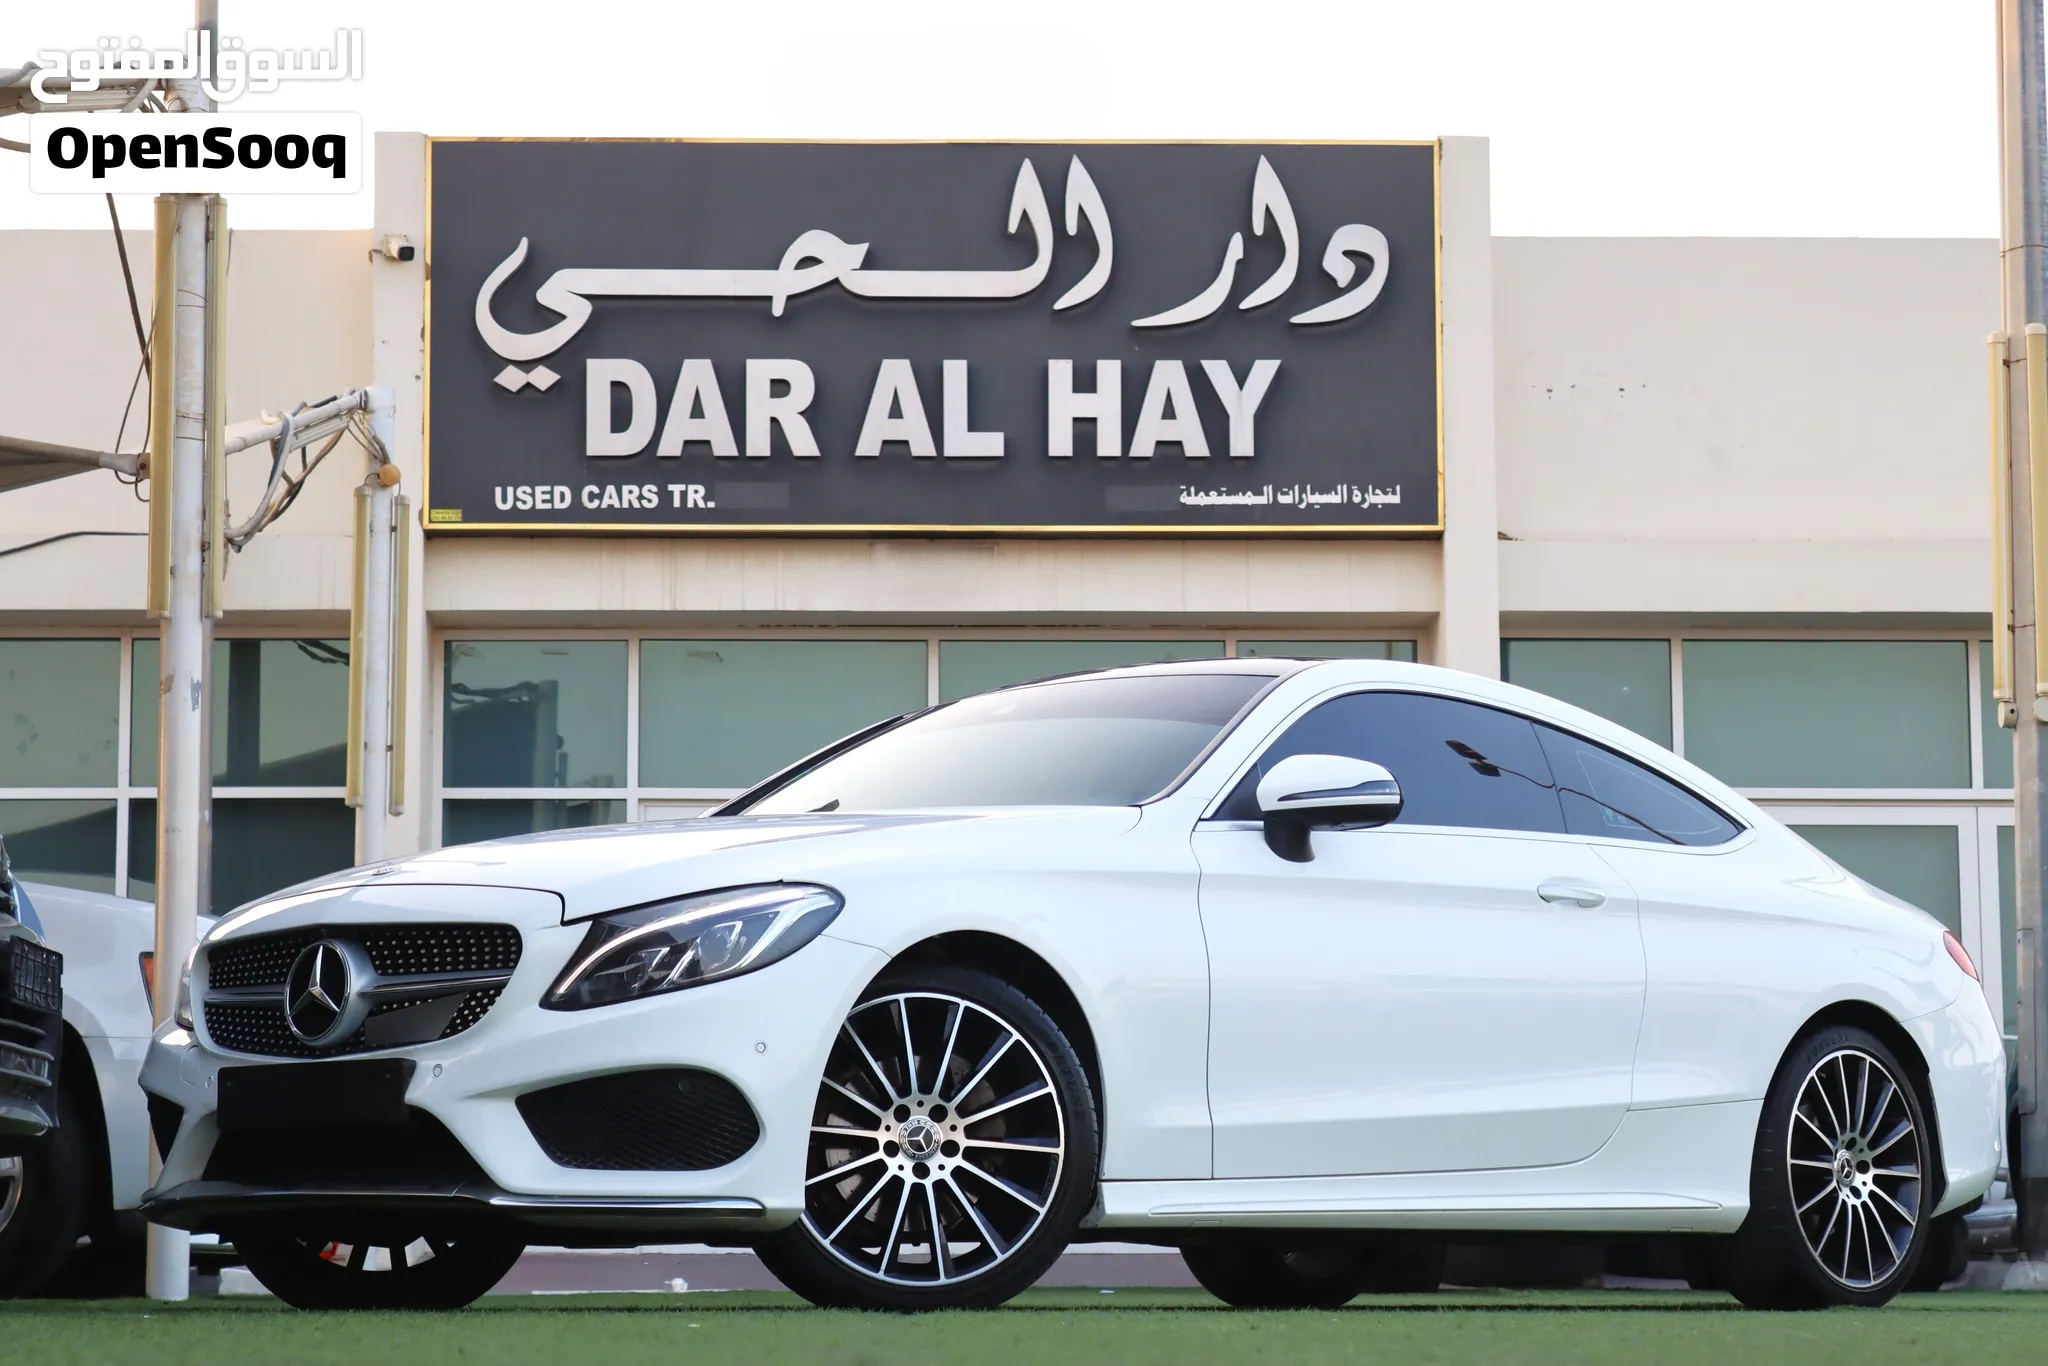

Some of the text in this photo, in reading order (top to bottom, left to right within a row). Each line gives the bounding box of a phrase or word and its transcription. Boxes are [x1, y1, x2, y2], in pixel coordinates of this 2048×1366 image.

[475, 154, 1113, 393] الحي
[586, 358, 1282, 457] DAR AL HAY
[494, 484, 716, 511] USED CARS TR.
[1179, 484, 1401, 509] لتجارة السيارات المستعملة
